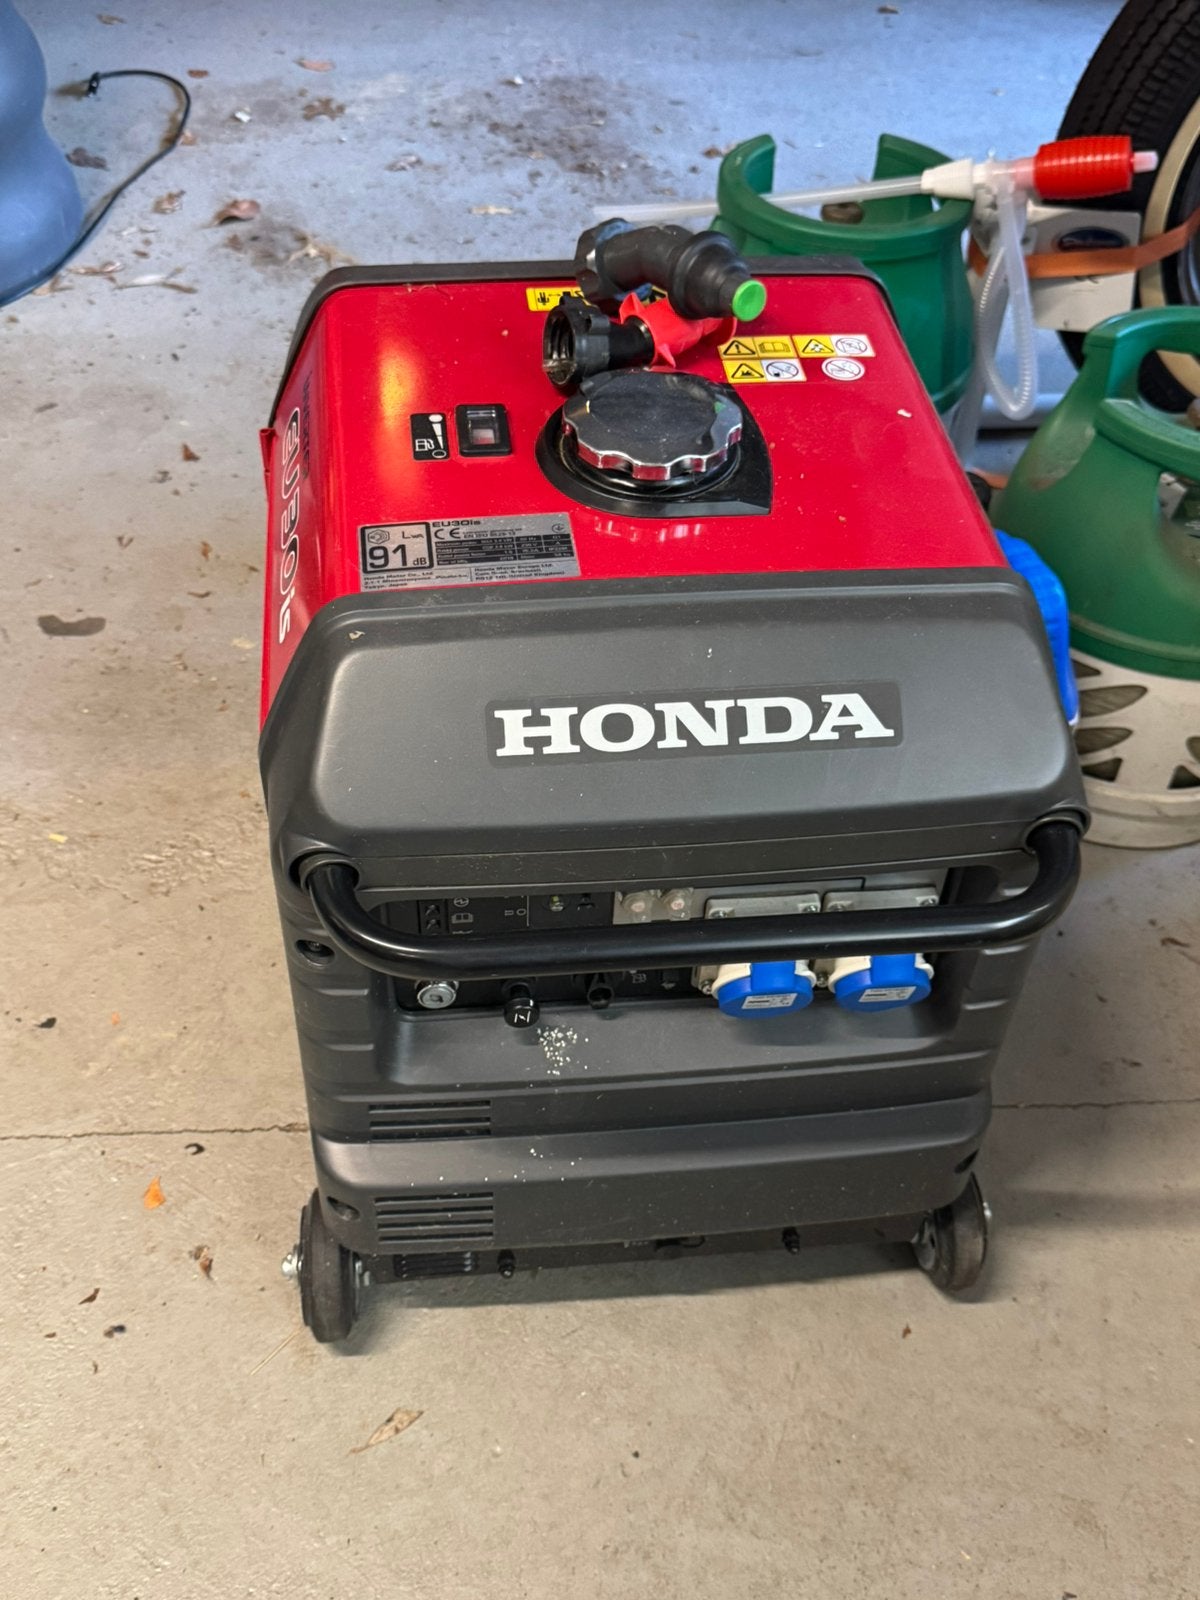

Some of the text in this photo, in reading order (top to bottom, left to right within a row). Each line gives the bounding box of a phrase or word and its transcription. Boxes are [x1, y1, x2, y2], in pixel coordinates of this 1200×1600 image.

[279, 406, 300, 644] EU30is
[432, 520, 481, 528] EU30is
[368, 544, 427, 569] 91 dB
[494, 692, 895, 757] HONDA
